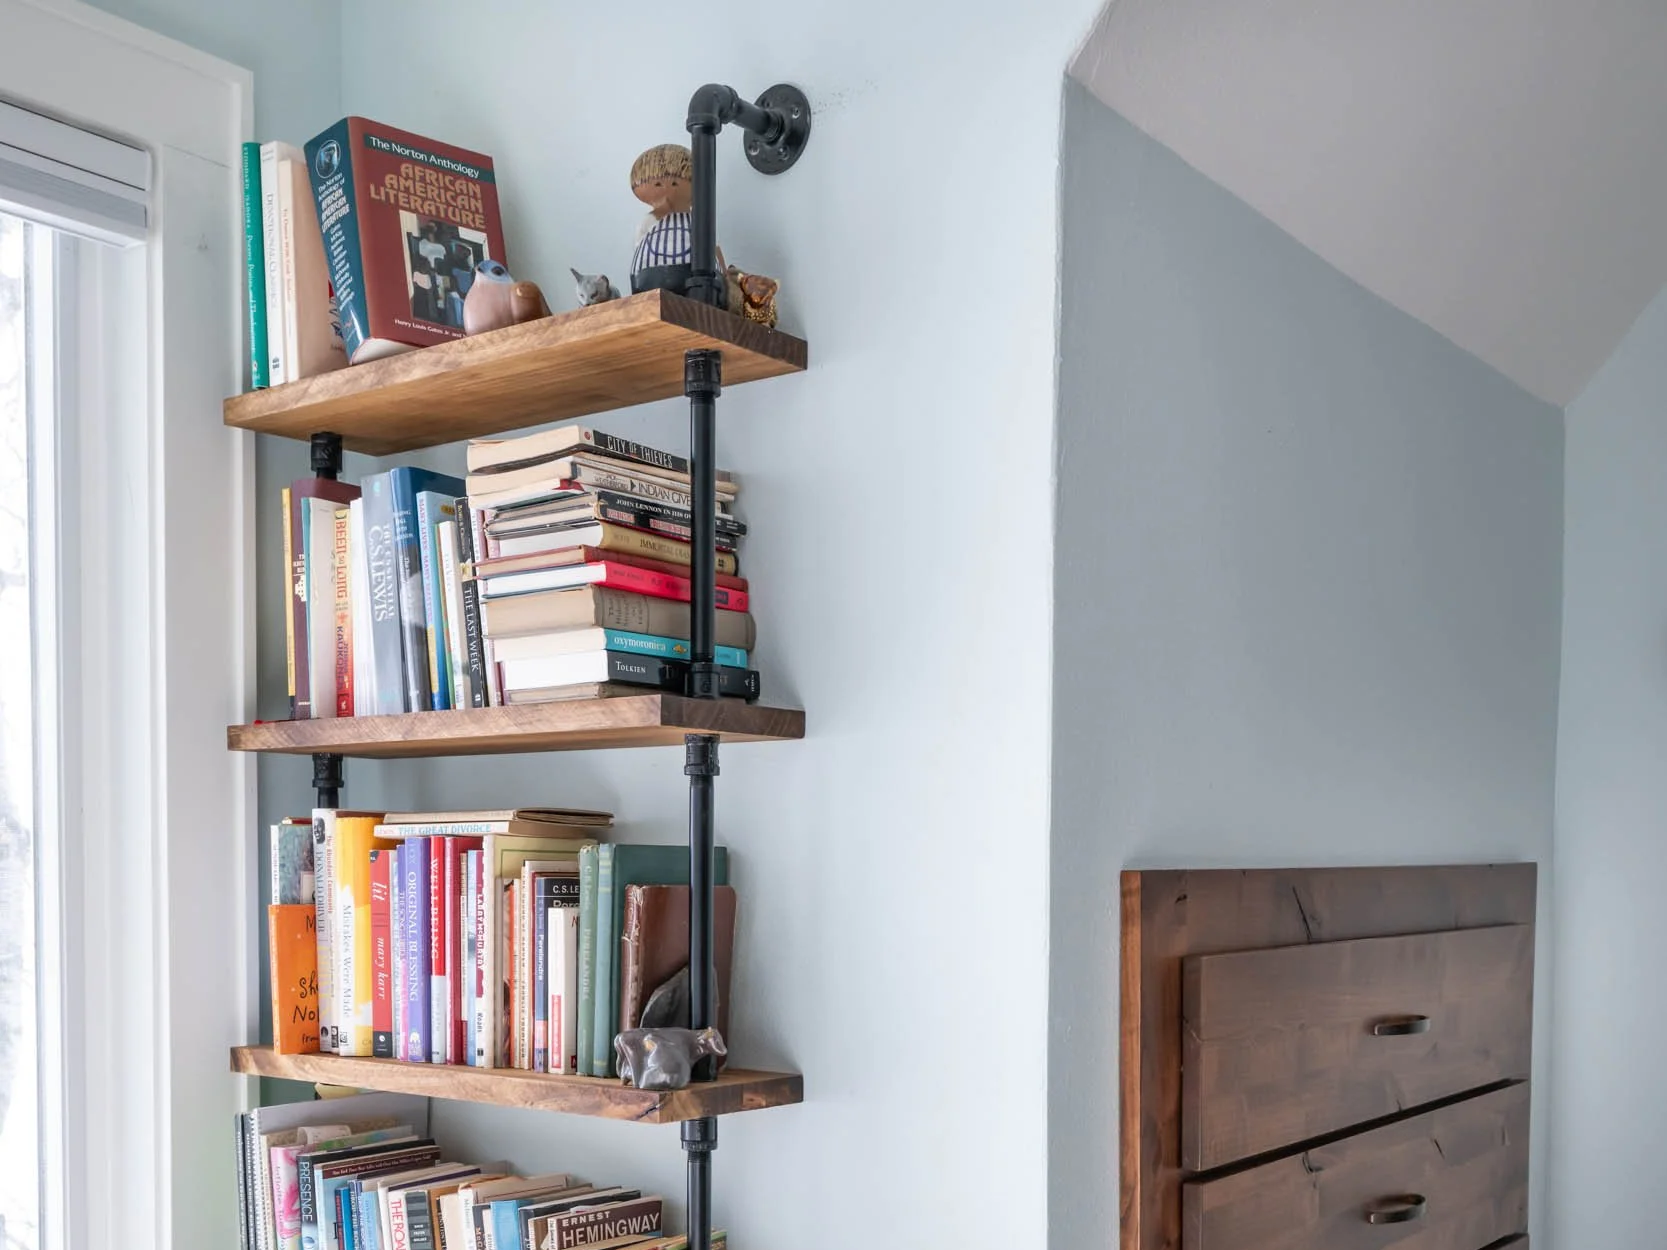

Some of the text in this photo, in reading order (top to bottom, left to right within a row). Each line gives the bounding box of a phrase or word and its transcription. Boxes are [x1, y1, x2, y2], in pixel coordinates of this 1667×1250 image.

[370, 137, 479, 178] The Norton Anthology
[385, 174, 483, 213] AMERICAN
[400, 163, 481, 199] AFRICAN
[370, 182, 485, 229] LITERATURE
[266, 193, 276, 260] DEVOTIONAL
[607, 436, 673, 468] CITY OF THIEVES
[616, 499, 635, 507] JOHN
[635, 501, 662, 513] LENNON
[638, 482, 670, 500] INDIAN
[383, 523, 392, 545] THE
[370, 560, 388, 622] LEWIS
[463, 588, 479, 672] THE LAST WEEK
[614, 636, 666, 651] oxymoronica
[398, 824, 491, 835] THE GREAT DIVORCE
[315, 850, 326, 932] DONALD DRIVER
[372, 881, 387, 901] lit
[407, 871, 419, 1001] ORIGINAL BLESSING
[342, 904, 353, 1018] Mistakes Were Made
[374, 937, 389, 1000] mary karr
[537, 934, 545, 981] Perelandra
[582, 928, 591, 1001] PERELANDRA
[274, 1165, 283, 1205] Infinite
[300, 1161, 313, 1222] PRESENCE
[390, 1199, 403, 1221] THE
[562, 1211, 611, 1226] ERNEST
[562, 1212, 659, 1248] HEMINGWAY
